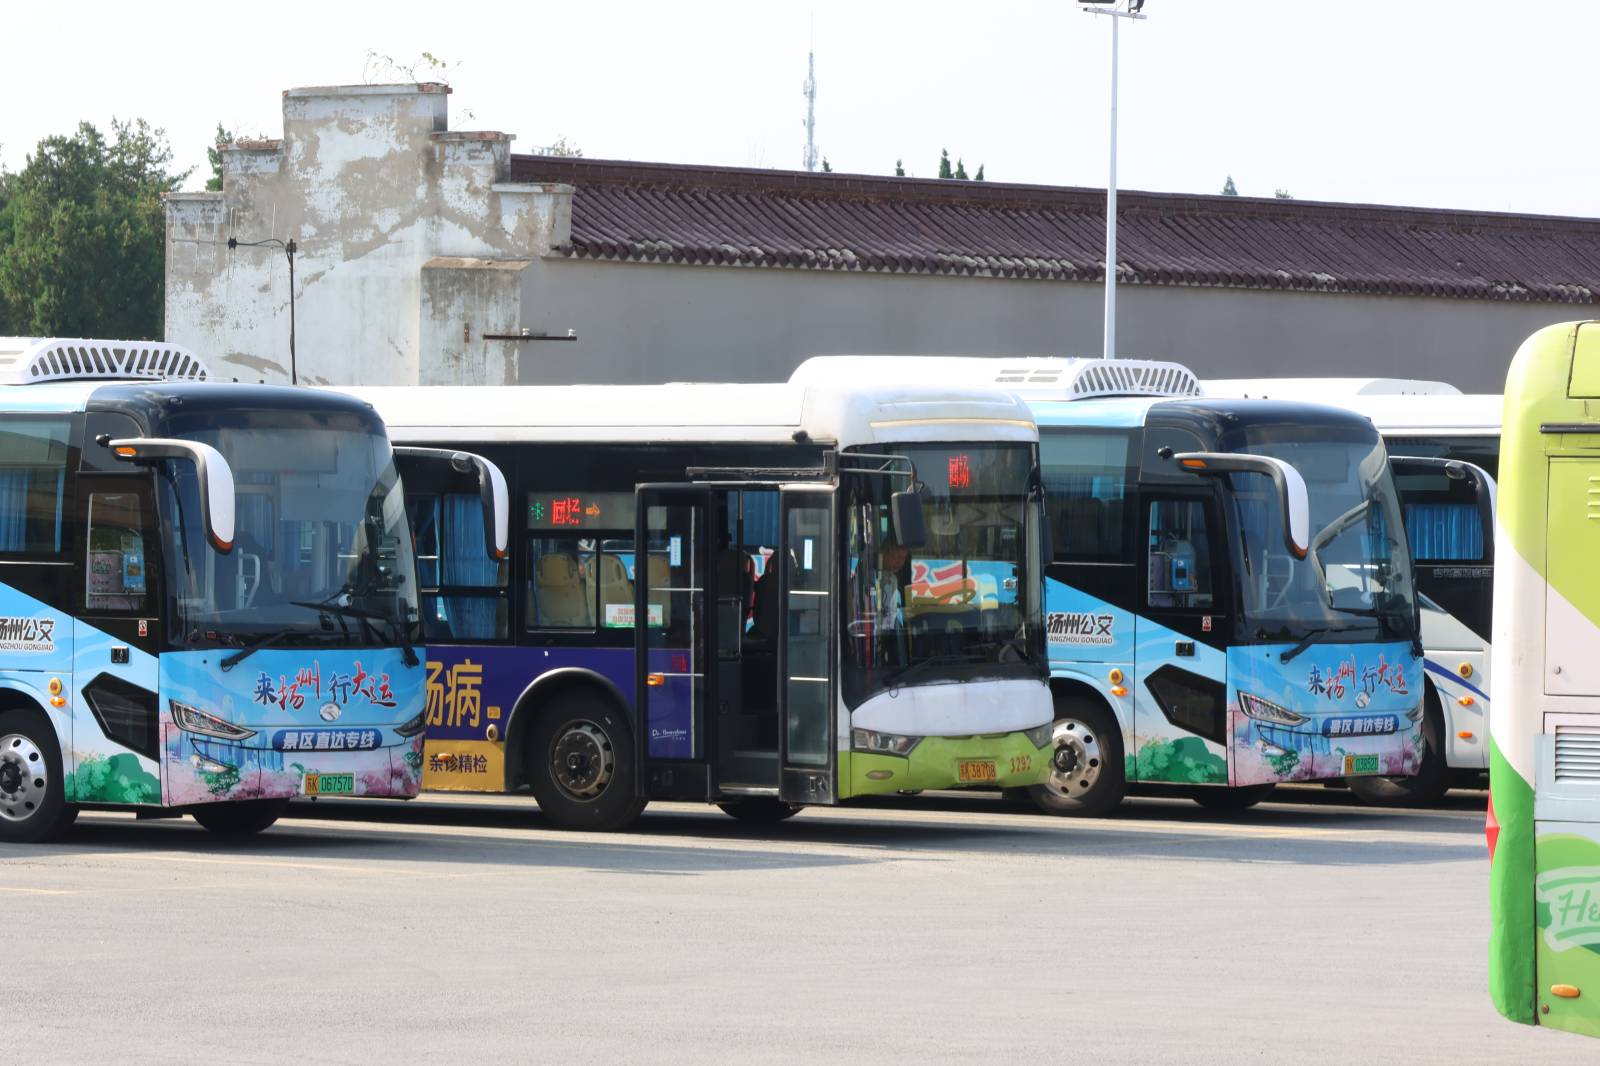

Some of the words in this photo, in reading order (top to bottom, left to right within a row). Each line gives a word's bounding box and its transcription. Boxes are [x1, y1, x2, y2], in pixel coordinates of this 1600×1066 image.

[1047, 613, 1113, 635] 扬州公交
[0, 642, 22, 650] NGZHOU
[24, 643, 54, 651] GONGJIAO
[1081, 637, 1113, 645] GONGJIAO
[254, 660, 320, 710] 来扬州
[329, 661, 397, 707] 行大运
[1309, 655, 1356, 700] 来扬州
[1362, 655, 1409, 695] 行大运
[1009, 755, 1032, 774] 3292
